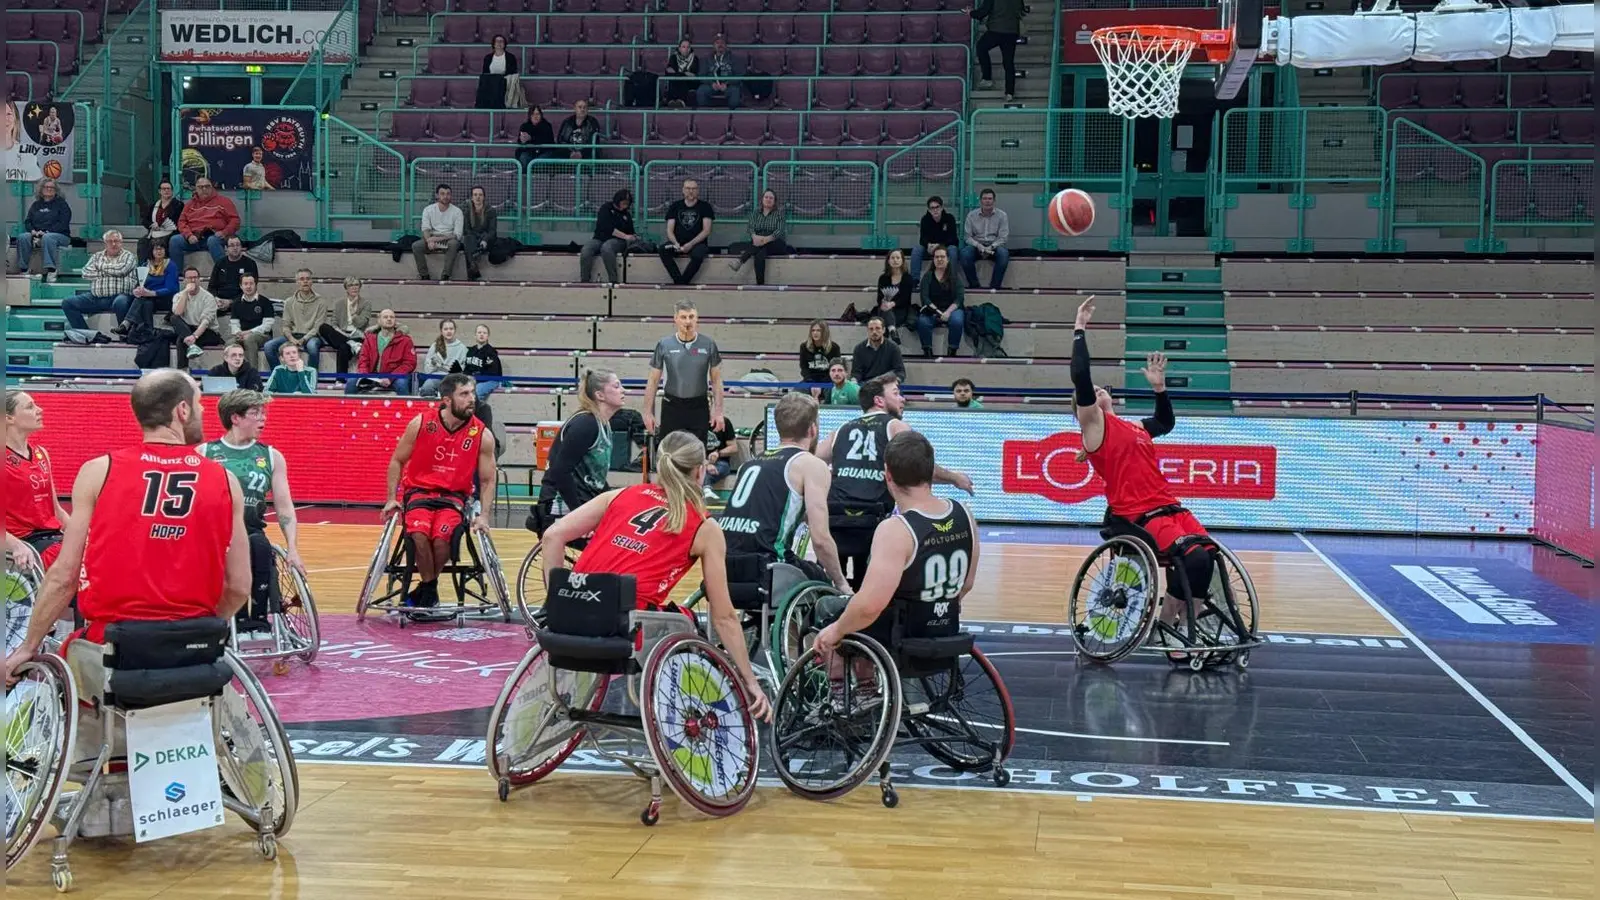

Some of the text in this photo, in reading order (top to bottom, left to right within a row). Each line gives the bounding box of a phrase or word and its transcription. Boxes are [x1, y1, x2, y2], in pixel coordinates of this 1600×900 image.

[19, 144, 66, 156] Lilly go!!!
[188, 133, 253, 149] Dillingen
[461, 437, 474, 451] 8
[846, 428, 878, 461] 24
[140, 453, 183, 465] Allianz
[1016, 446, 1262, 490] L'OERIA
[247, 470, 267, 493] 22
[837, 466, 886, 482] IGUANAS
[141, 470, 199, 519] 15
[731, 465, 761, 508] 0
[149, 523, 187, 541] HOPP
[628, 505, 670, 537] 4
[718, 516, 760, 533] UANAS
[920, 549, 969, 602] 99
[155, 743, 209, 764] DEKRA
[139, 800, 217, 825] schlaeger
